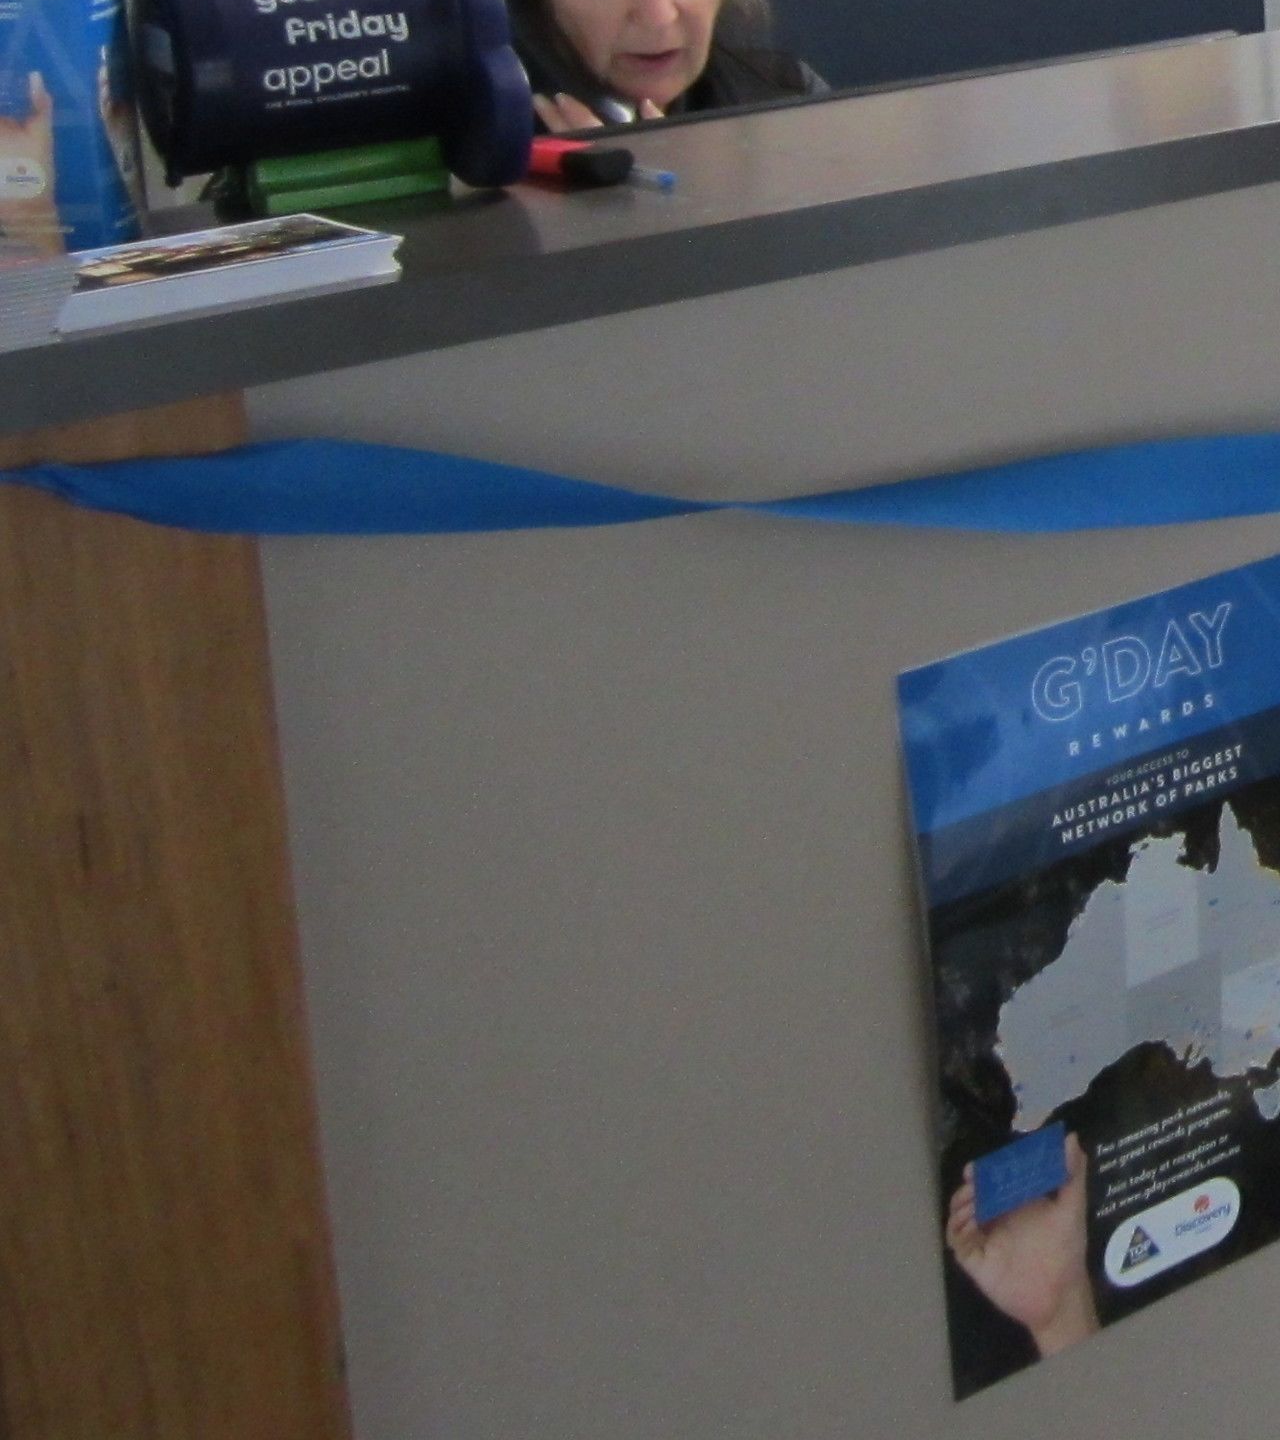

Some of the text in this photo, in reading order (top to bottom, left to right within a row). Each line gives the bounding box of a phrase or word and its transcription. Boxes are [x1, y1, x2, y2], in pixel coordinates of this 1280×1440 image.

[285, 9, 409, 45] friday
[263, 48, 390, 96] appeal
[1032, 602, 1233, 722] G'DAY
[1068, 693, 1215, 757] REWARDS
[1051, 744, 1243, 828] AUSTRALIA'S BIGGEST
[1135, 755, 1173, 776] ACCESS
[1177, 748, 1190, 760] TO
[1061, 765, 1239, 844] NETWORK OF PARKS
[1175, 1203, 1231, 1237] Discovery
